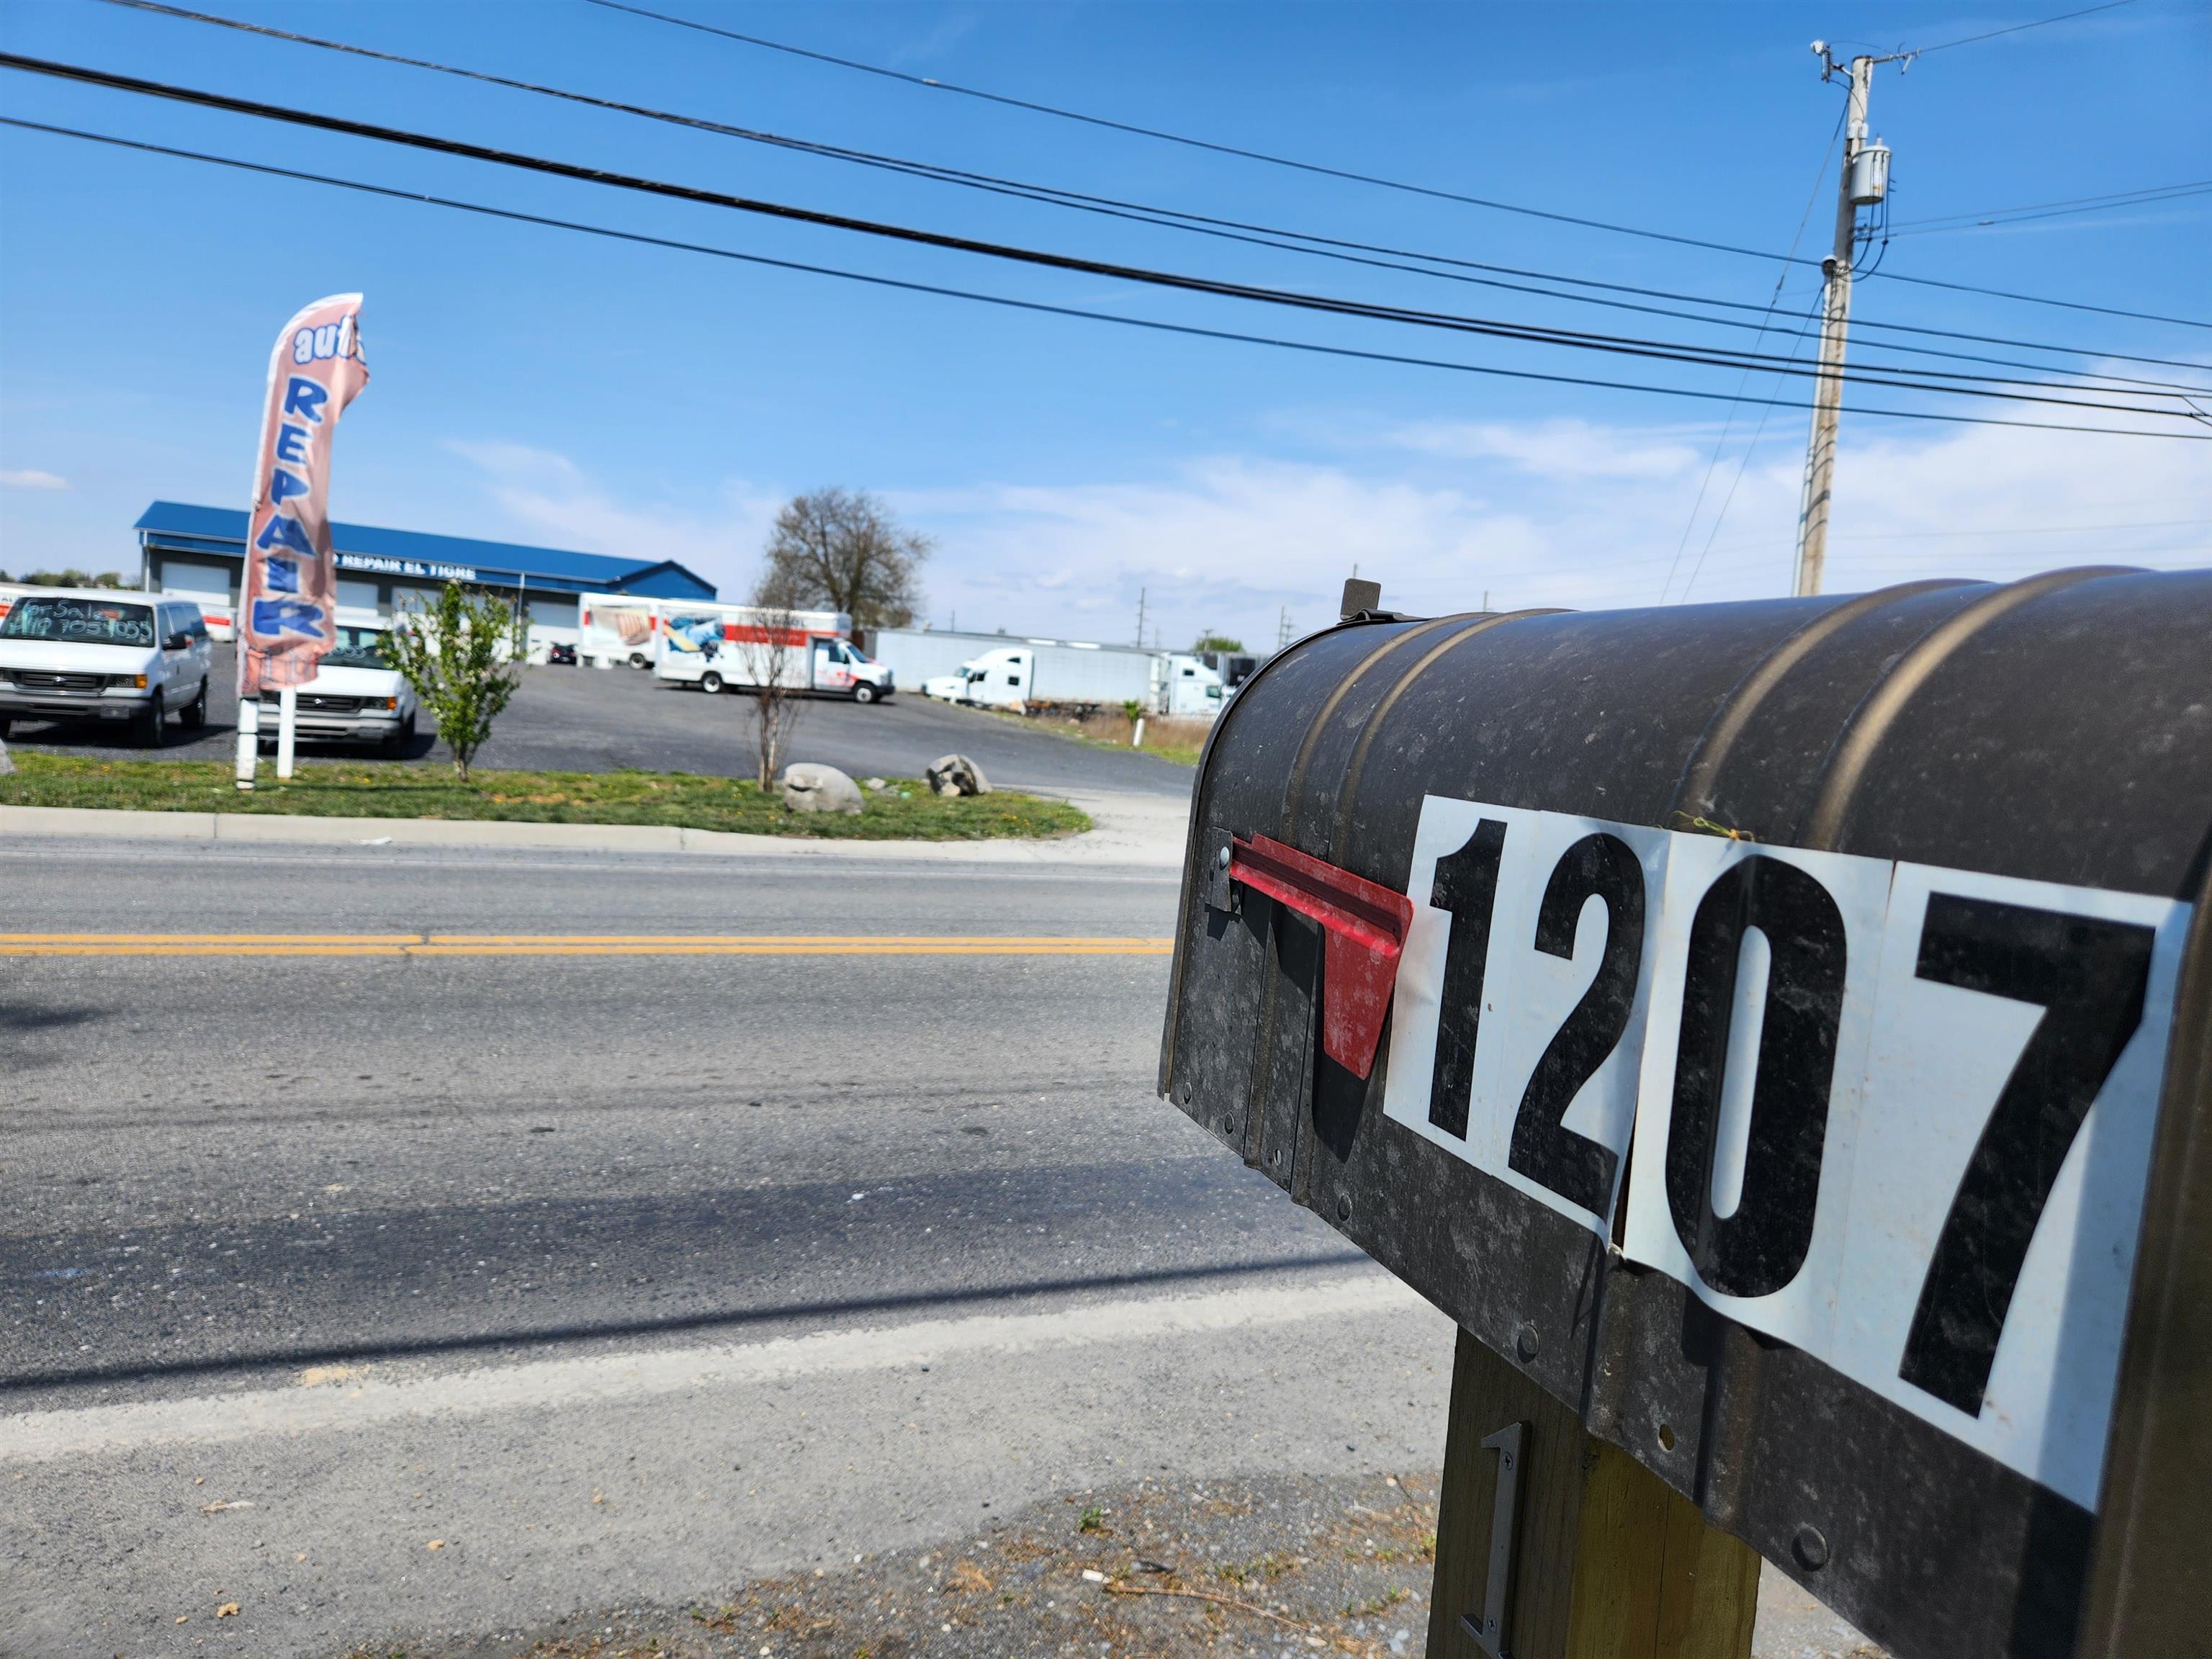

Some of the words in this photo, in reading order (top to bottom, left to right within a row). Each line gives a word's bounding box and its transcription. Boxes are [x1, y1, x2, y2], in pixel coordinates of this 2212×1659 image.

[253, 376, 328, 639] REPAIR
[342, 554, 402, 572] REPAIR
[404, 562, 426, 575] EL
[430, 565, 477, 580] TIGRE
[53, 599, 108, 621] Sale
[1429, 817, 2156, 1418] 1207
